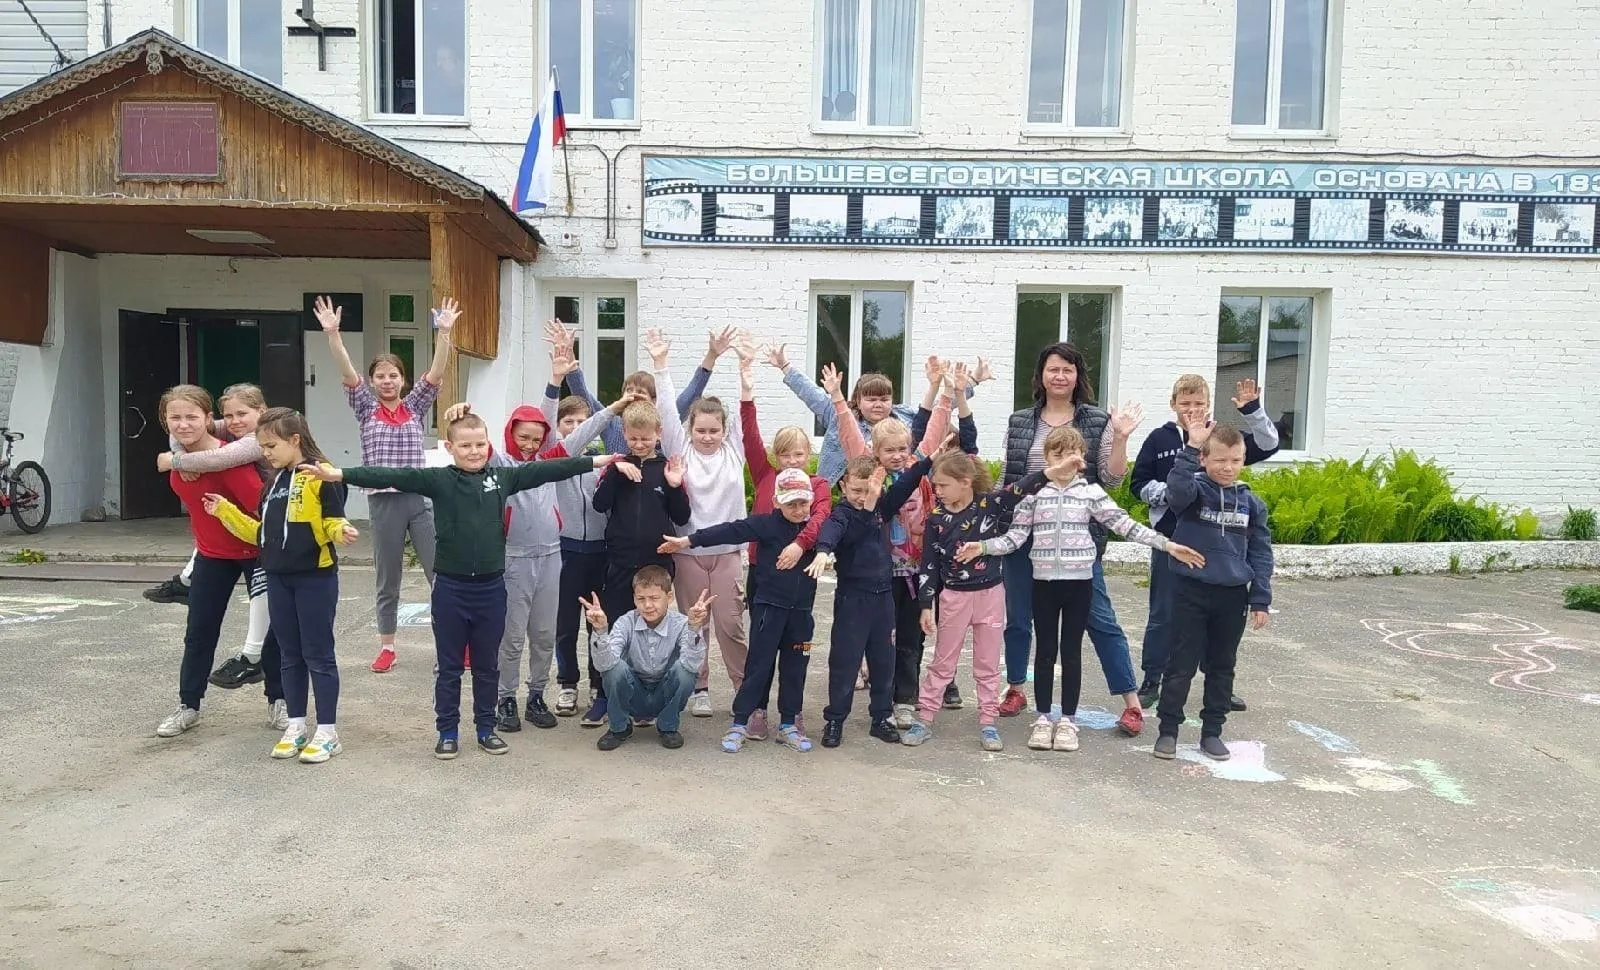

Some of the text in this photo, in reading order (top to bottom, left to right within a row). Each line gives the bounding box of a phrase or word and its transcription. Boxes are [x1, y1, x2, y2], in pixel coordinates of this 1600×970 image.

[727, 164, 1154, 187] БОЛЬШЕВСЕГОДИЧЕСКАЯ
[1164, 168, 1293, 188] ШКОЛА
[1314, 169, 1501, 191] ОСНОВАНА
[1512, 173, 1535, 192] В
